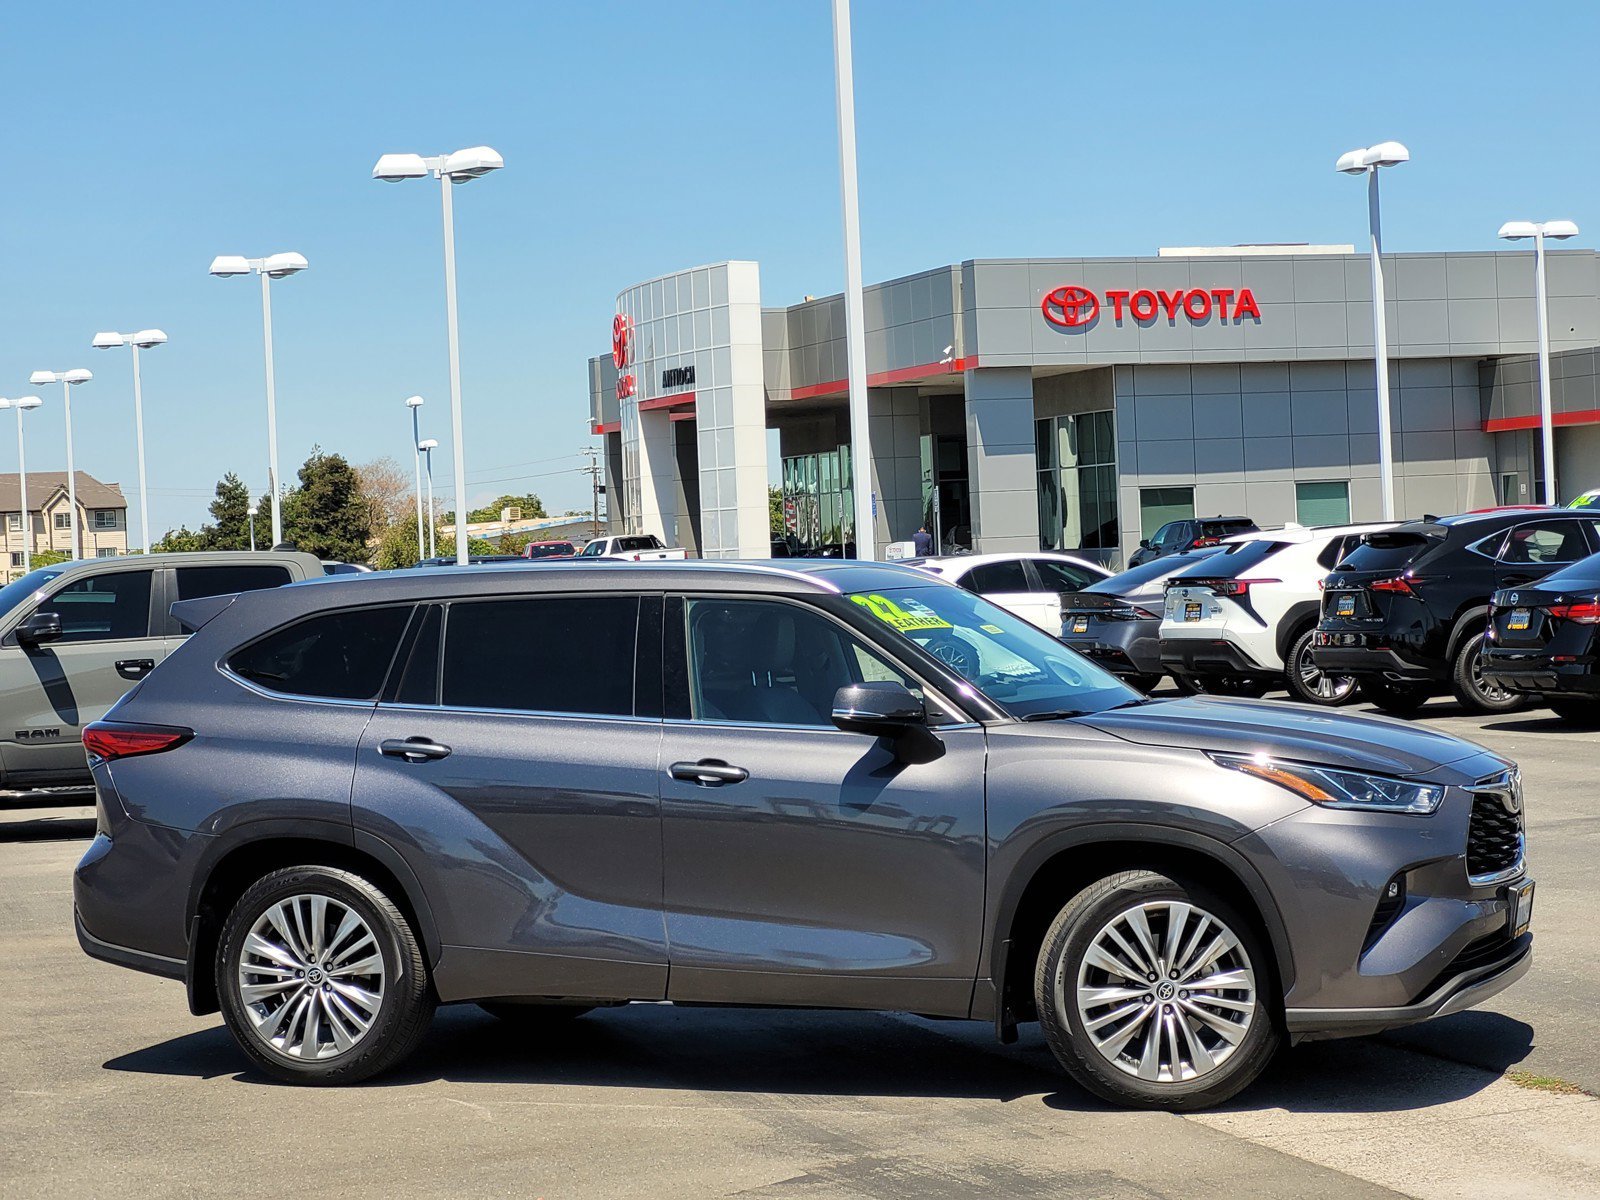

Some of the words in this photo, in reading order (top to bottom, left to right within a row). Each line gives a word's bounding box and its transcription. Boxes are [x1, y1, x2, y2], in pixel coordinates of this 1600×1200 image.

[1105, 288, 1262, 320] TOYOTA
[662, 365, 695, 388] ANTIOCH
[850, 594, 914, 621] 22
[15, 728, 60, 739] RAM
